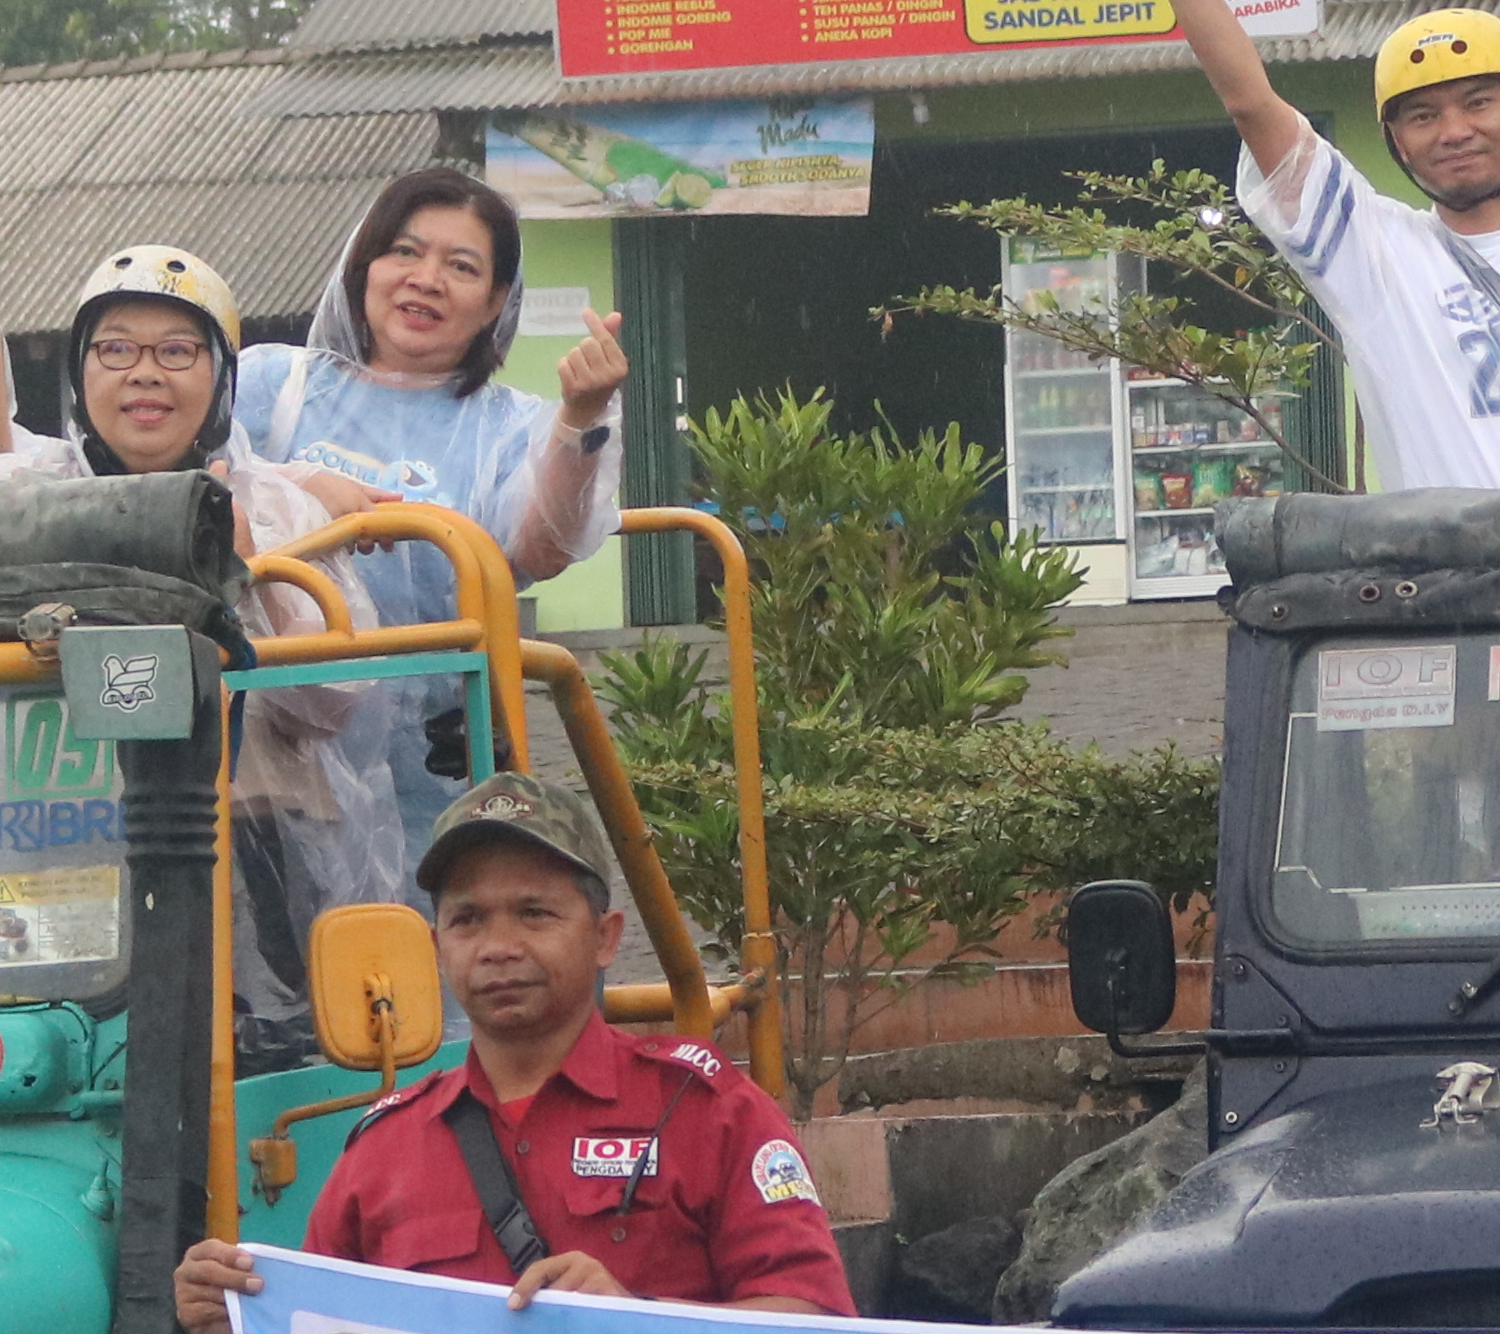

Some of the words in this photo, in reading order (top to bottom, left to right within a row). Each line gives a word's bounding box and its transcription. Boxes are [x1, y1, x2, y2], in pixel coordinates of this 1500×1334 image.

[616, 2, 673, 15] INDOMIE
[813, 3, 838, 16] TEH
[840, 2, 886, 14] PANAS
[983, 6, 1086, 30] SANDAL
[1093, 1, 1156, 23] JEPIT
[617, 15, 673, 28] INDOMIE
[676, 10, 732, 24] GORENG
[813, 17, 848, 30] SUSU
[850, 14, 896, 28] PANAS
[908, 10, 956, 24] DINGIN
[618, 29, 647, 41] POP
[648, 27, 672, 40] MIE
[814, 29, 859, 43] ANEKA
[861, 27, 893, 40] KOPI
[619, 40, 694, 55] GORENGAN
[1326, 654, 1450, 687] IOF
[1322, 707, 1397, 722] Pengda
[669, 1043, 722, 1077] MLCC
[578, 1139, 651, 1159] IOF
